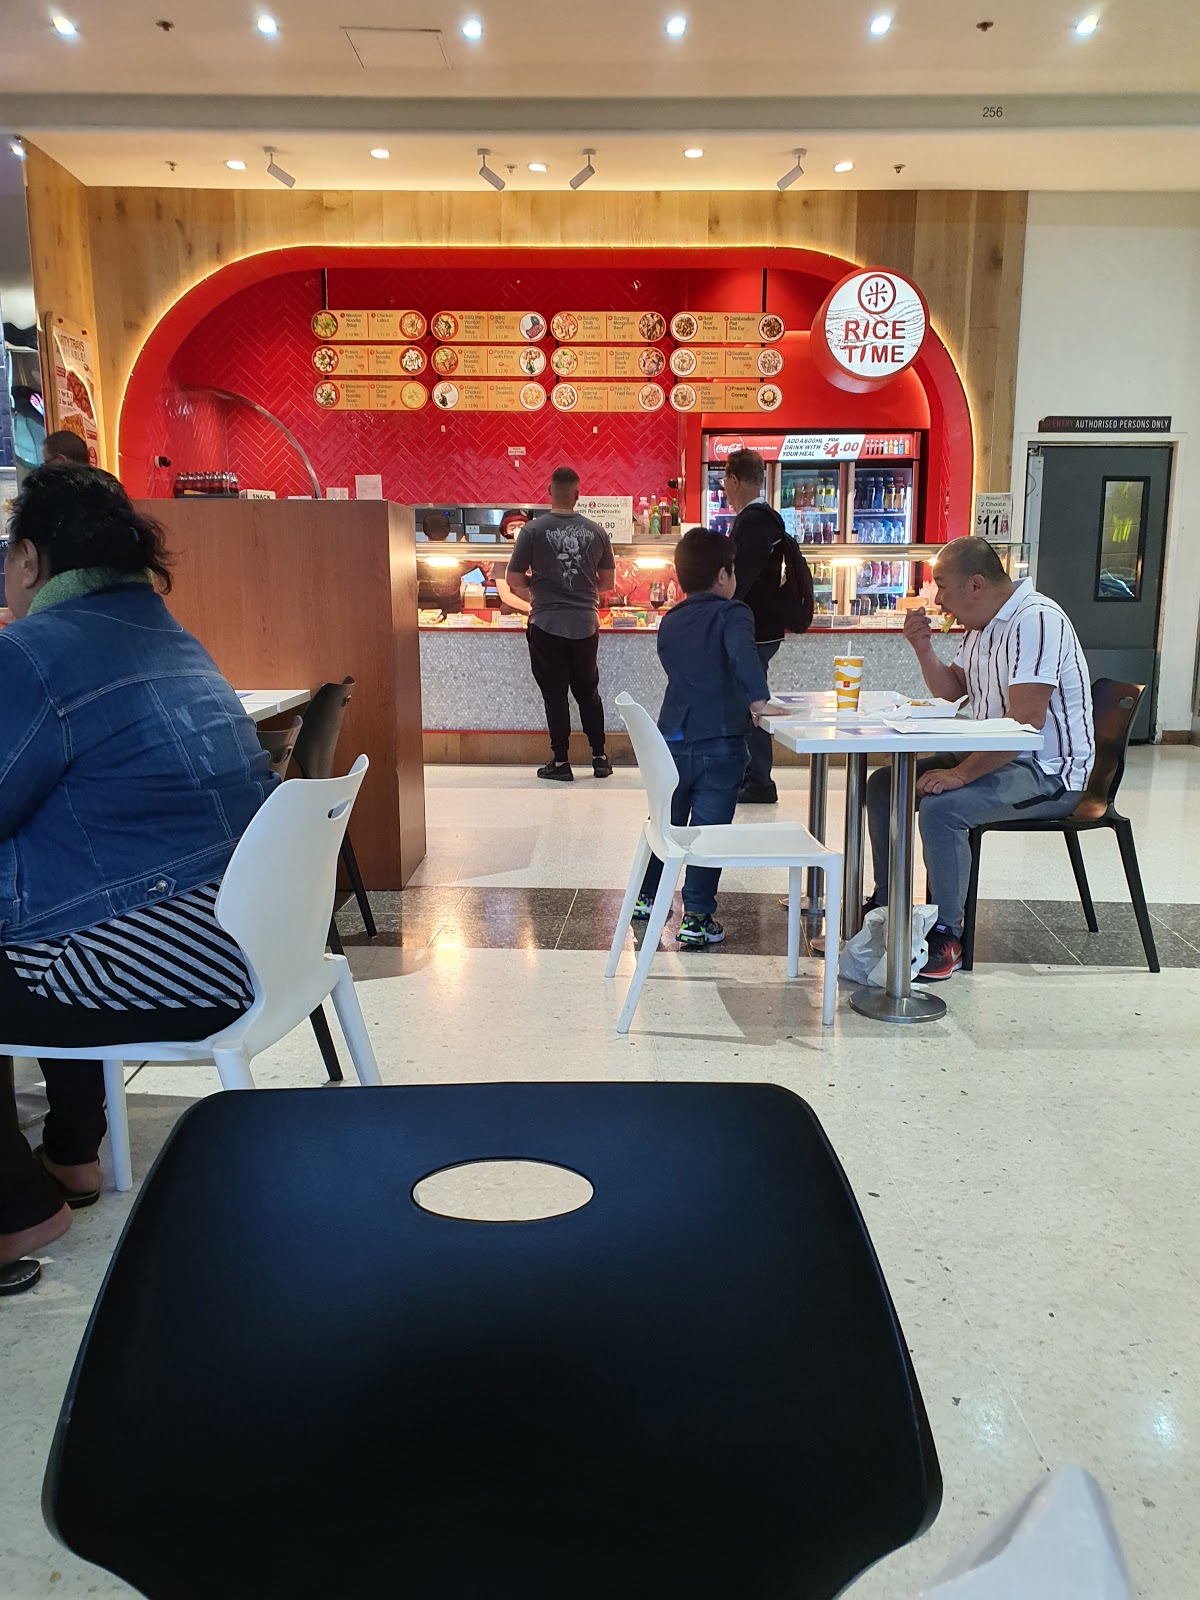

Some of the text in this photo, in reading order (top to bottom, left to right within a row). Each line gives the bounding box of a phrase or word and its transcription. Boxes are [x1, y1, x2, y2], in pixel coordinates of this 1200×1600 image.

[982, 107, 1003, 118] 256
[865, 281, 888, 308] 米
[844, 320, 906, 340] RICE
[840, 345, 905, 363] TIME
[1075, 420, 1118, 428] AUTHORISED
[1120, 420, 1150, 428] PERSONS
[1152, 420, 1169, 428] ONLY
[823, 442, 860, 458] $4.00
